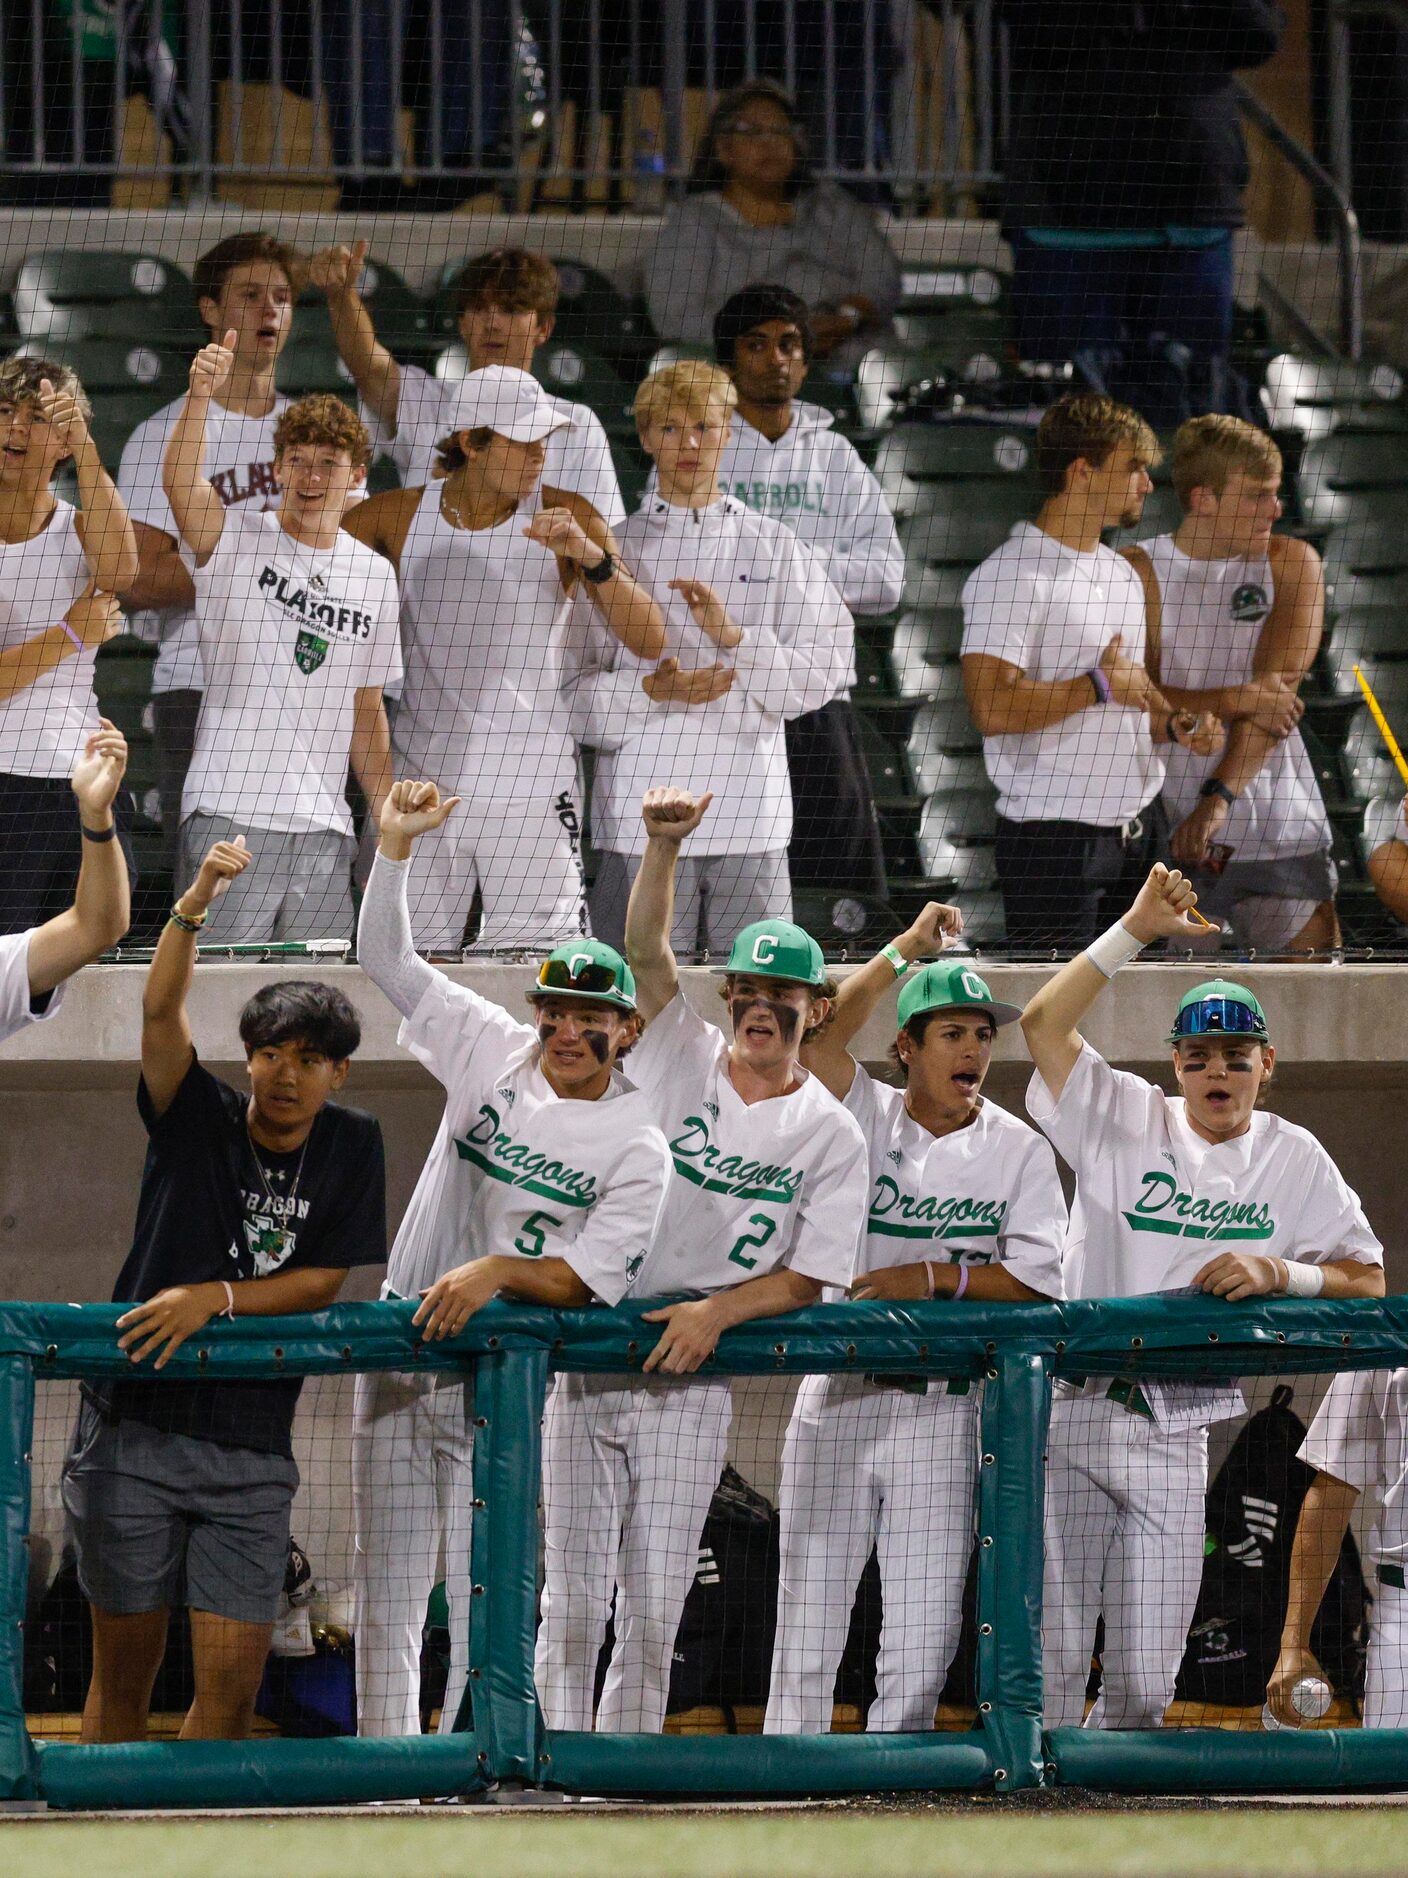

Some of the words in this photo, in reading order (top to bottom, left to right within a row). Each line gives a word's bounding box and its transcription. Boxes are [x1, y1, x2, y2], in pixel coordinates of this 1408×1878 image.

[752, 934, 779, 966] C
[961, 971, 984, 1000] C
[462, 1104, 597, 1206] Dragons
[669, 1116, 805, 1203] Dragons
[514, 1210, 563, 1257] 5
[869, 1174, 1008, 1238] Dragons
[1133, 1171, 1275, 1240] Dragons
[728, 1213, 777, 1270] 2
